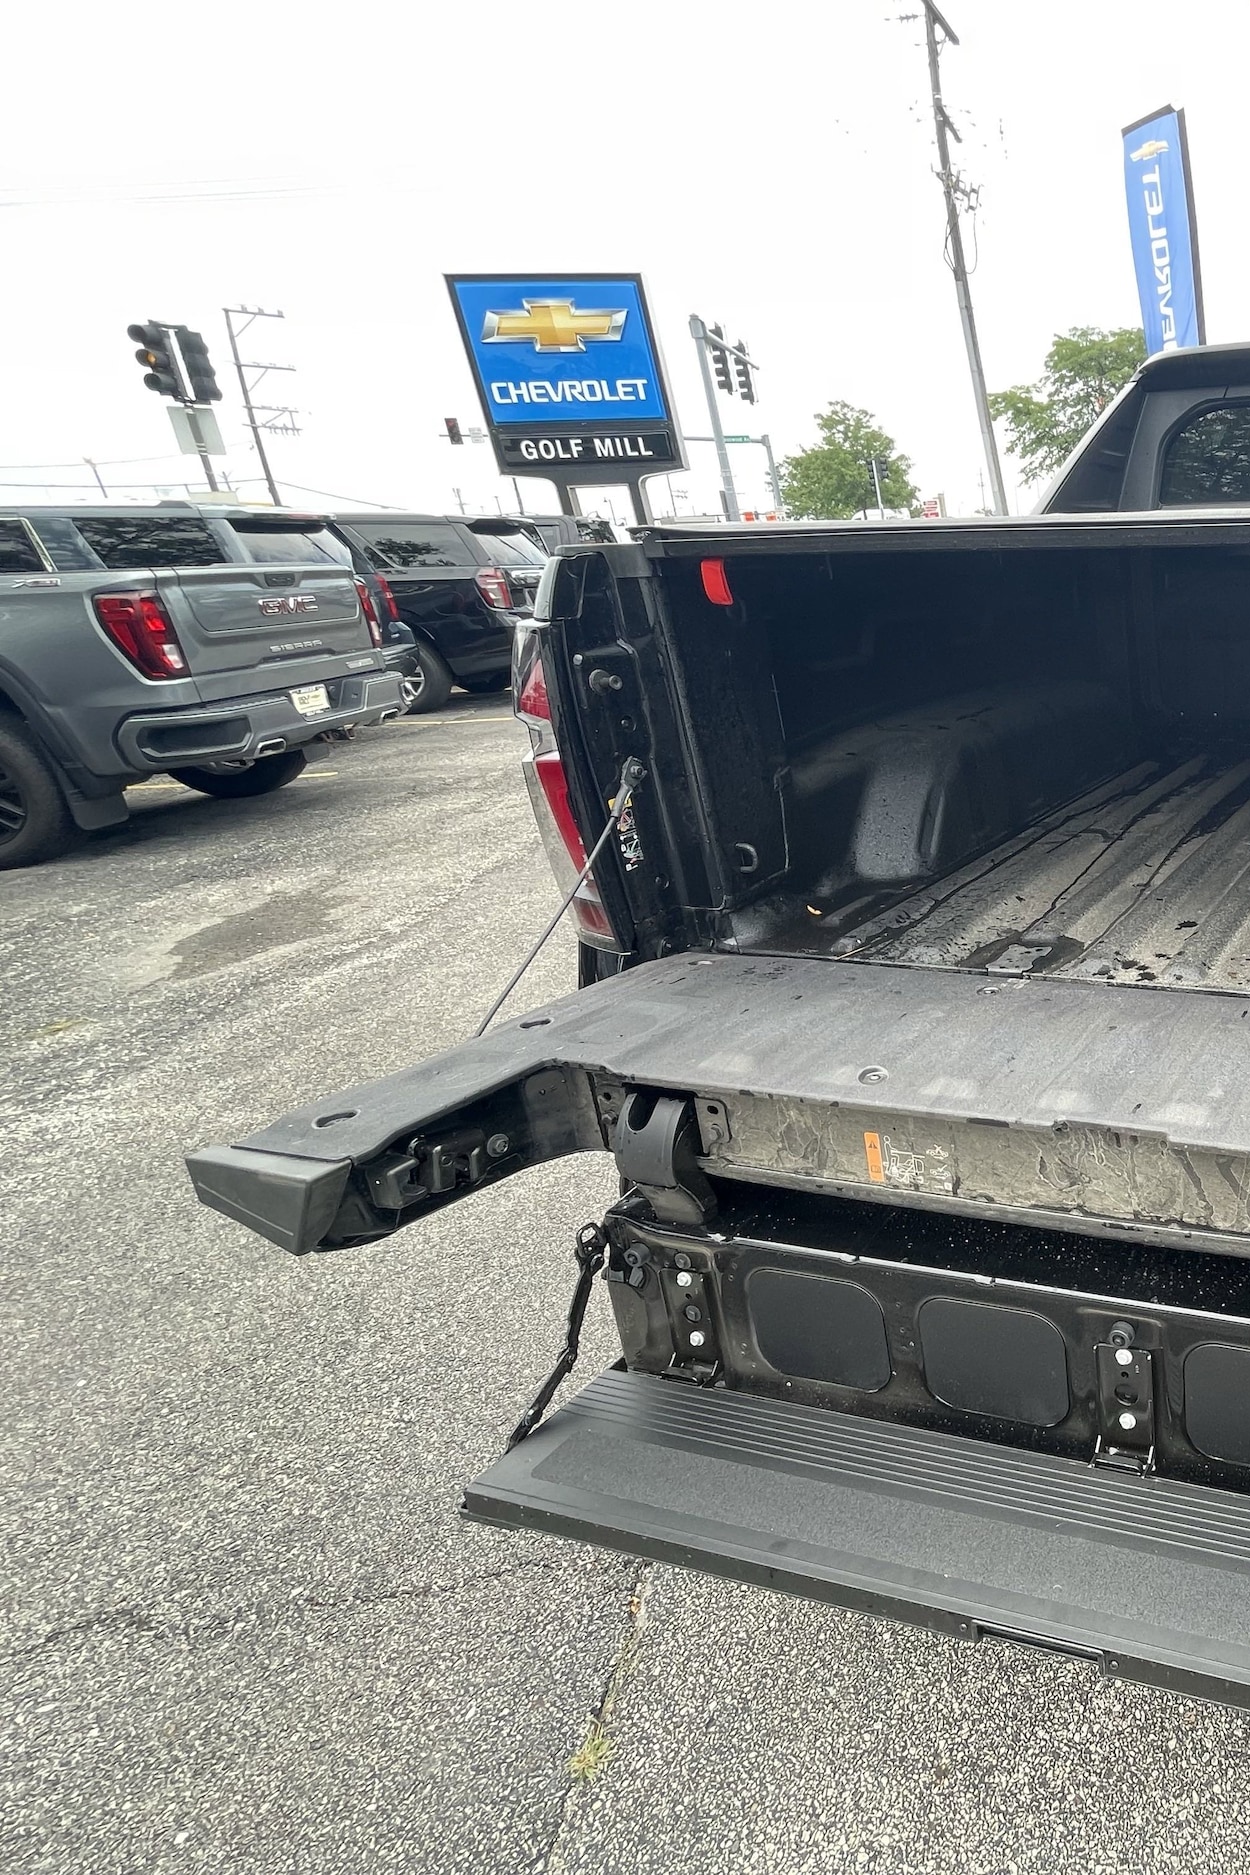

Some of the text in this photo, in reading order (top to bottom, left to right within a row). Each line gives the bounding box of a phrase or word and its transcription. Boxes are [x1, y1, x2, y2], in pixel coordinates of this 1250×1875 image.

[490, 379, 648, 404] CHEVROLET
[520, 436, 653, 461] GOLF MILL
[257, 595, 318, 616] GMC
[269, 639, 323, 653] SIERRA
